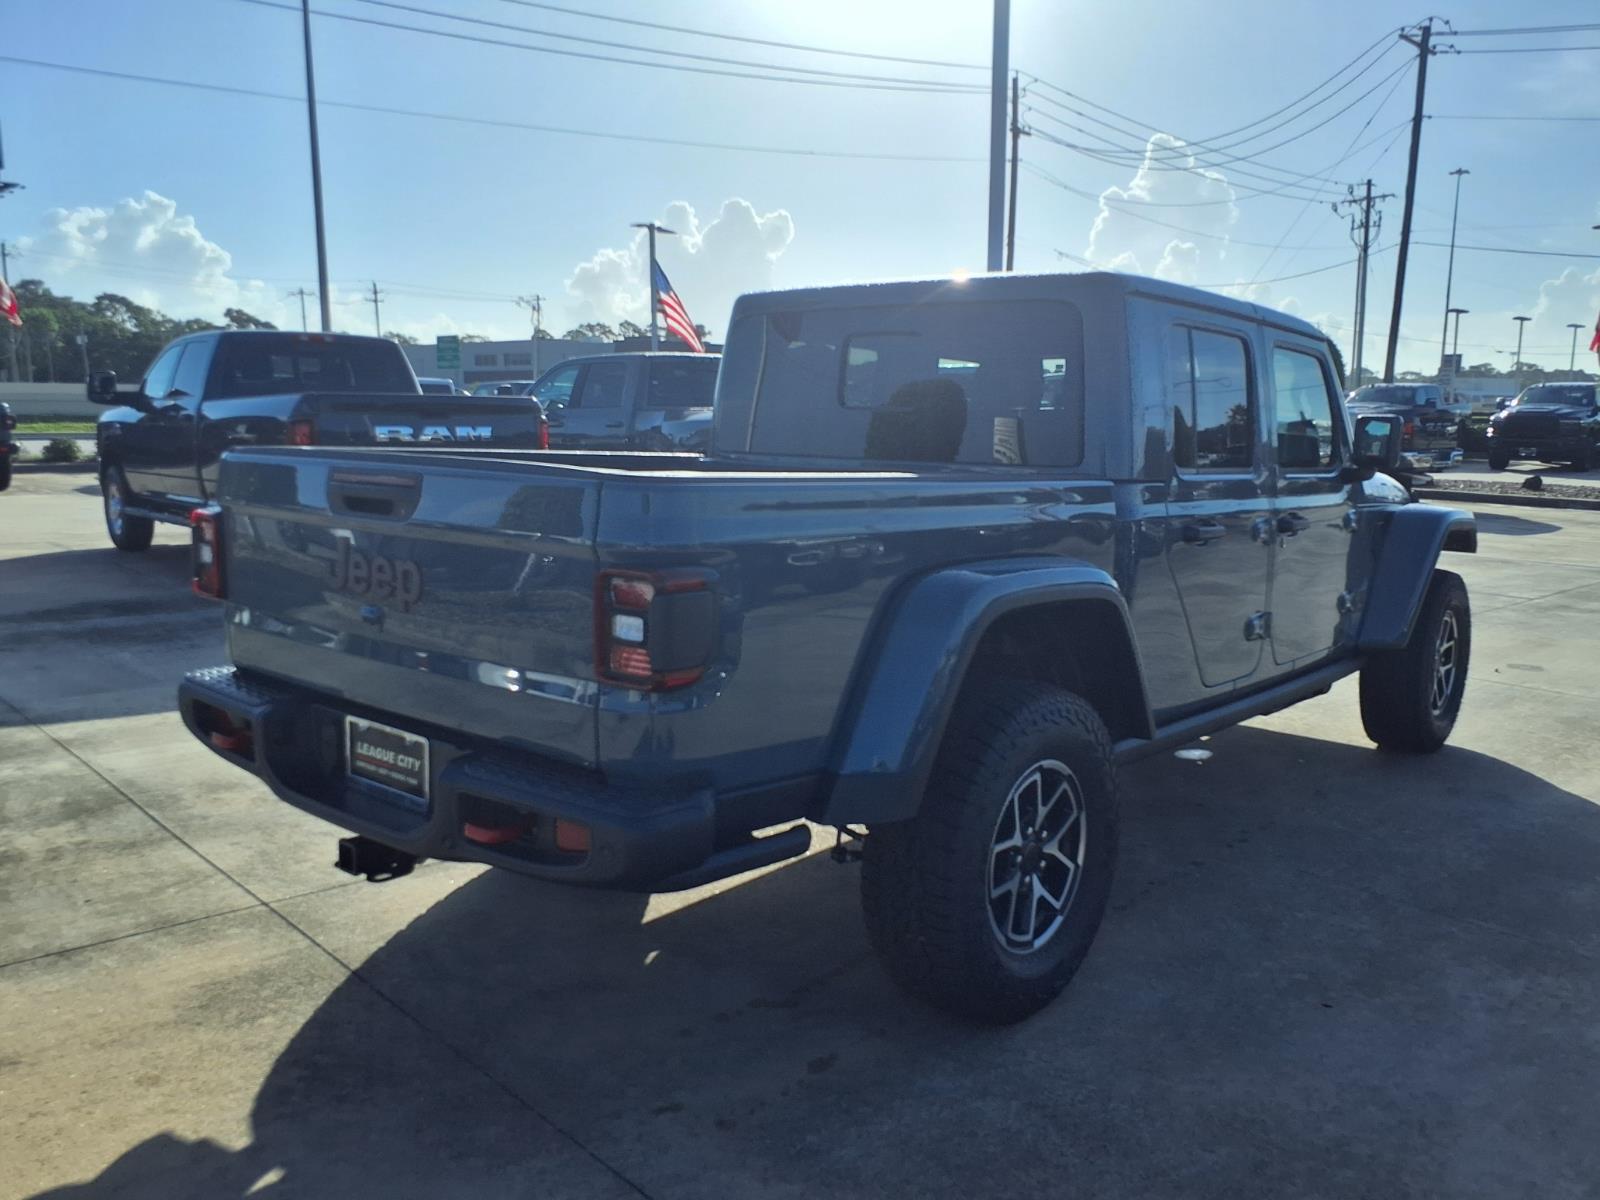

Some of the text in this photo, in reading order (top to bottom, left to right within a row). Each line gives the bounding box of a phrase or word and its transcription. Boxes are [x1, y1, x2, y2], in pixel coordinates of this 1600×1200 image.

[375, 426, 492, 442] RAM
[325, 535, 422, 612] Jeep
[356, 741, 421, 771] LEAGUE CITY
